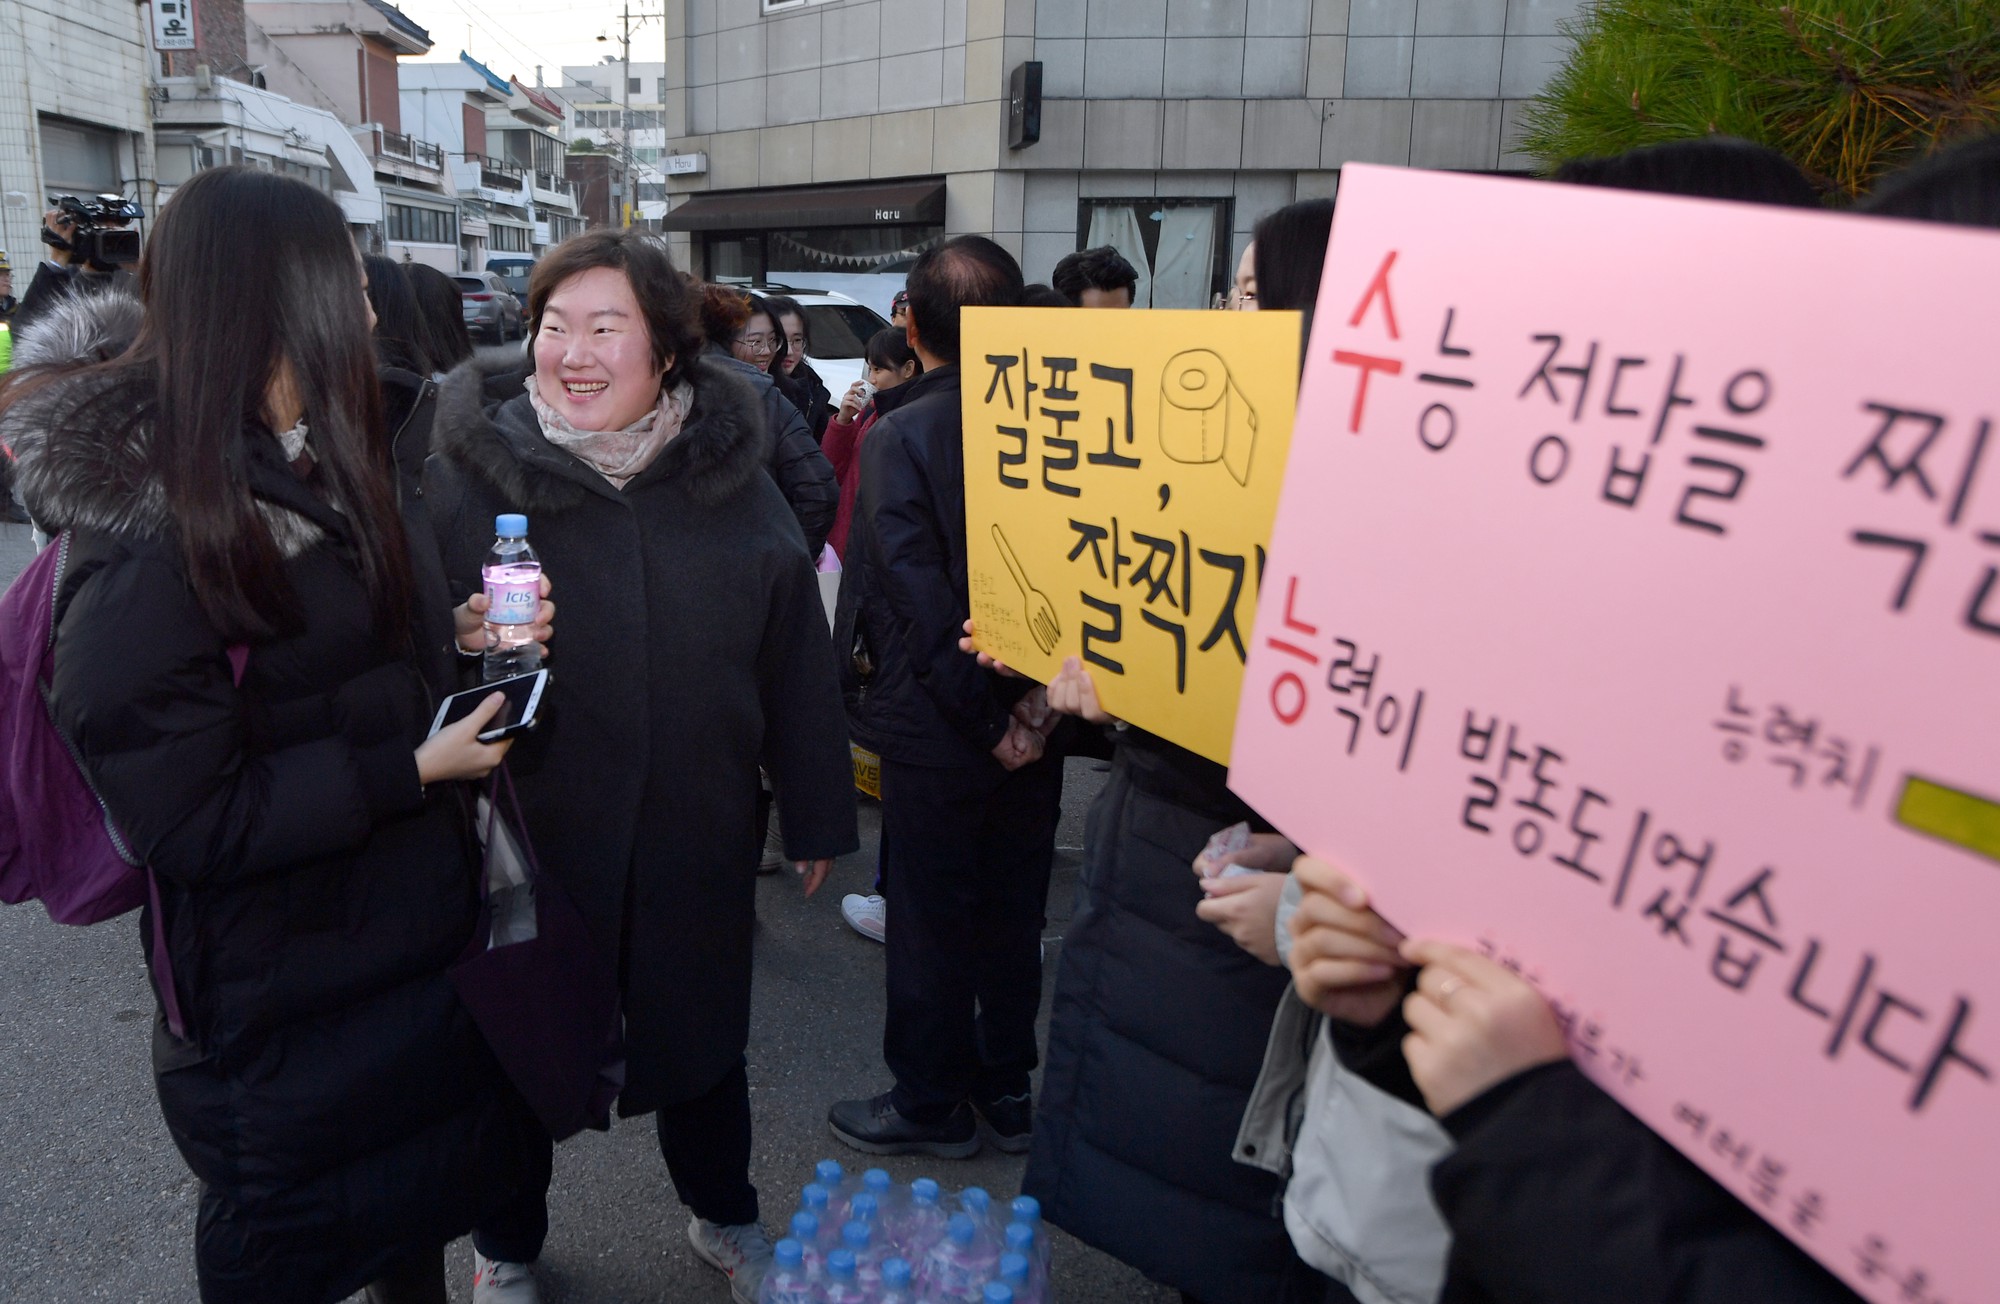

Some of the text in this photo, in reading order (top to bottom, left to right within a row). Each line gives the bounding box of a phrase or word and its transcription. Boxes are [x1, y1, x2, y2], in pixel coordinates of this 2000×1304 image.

[674, 157, 692, 169] Haru
[875, 209, 900, 220] Haru
[1330, 248, 1477, 454] 수능
[1517, 332, 1774, 538] 정답을
[1712, 684, 1883, 811] 능력치
[1267, 576, 1426, 773] 능력이
[1459, 710, 1996, 1116] 발동되었습니다
